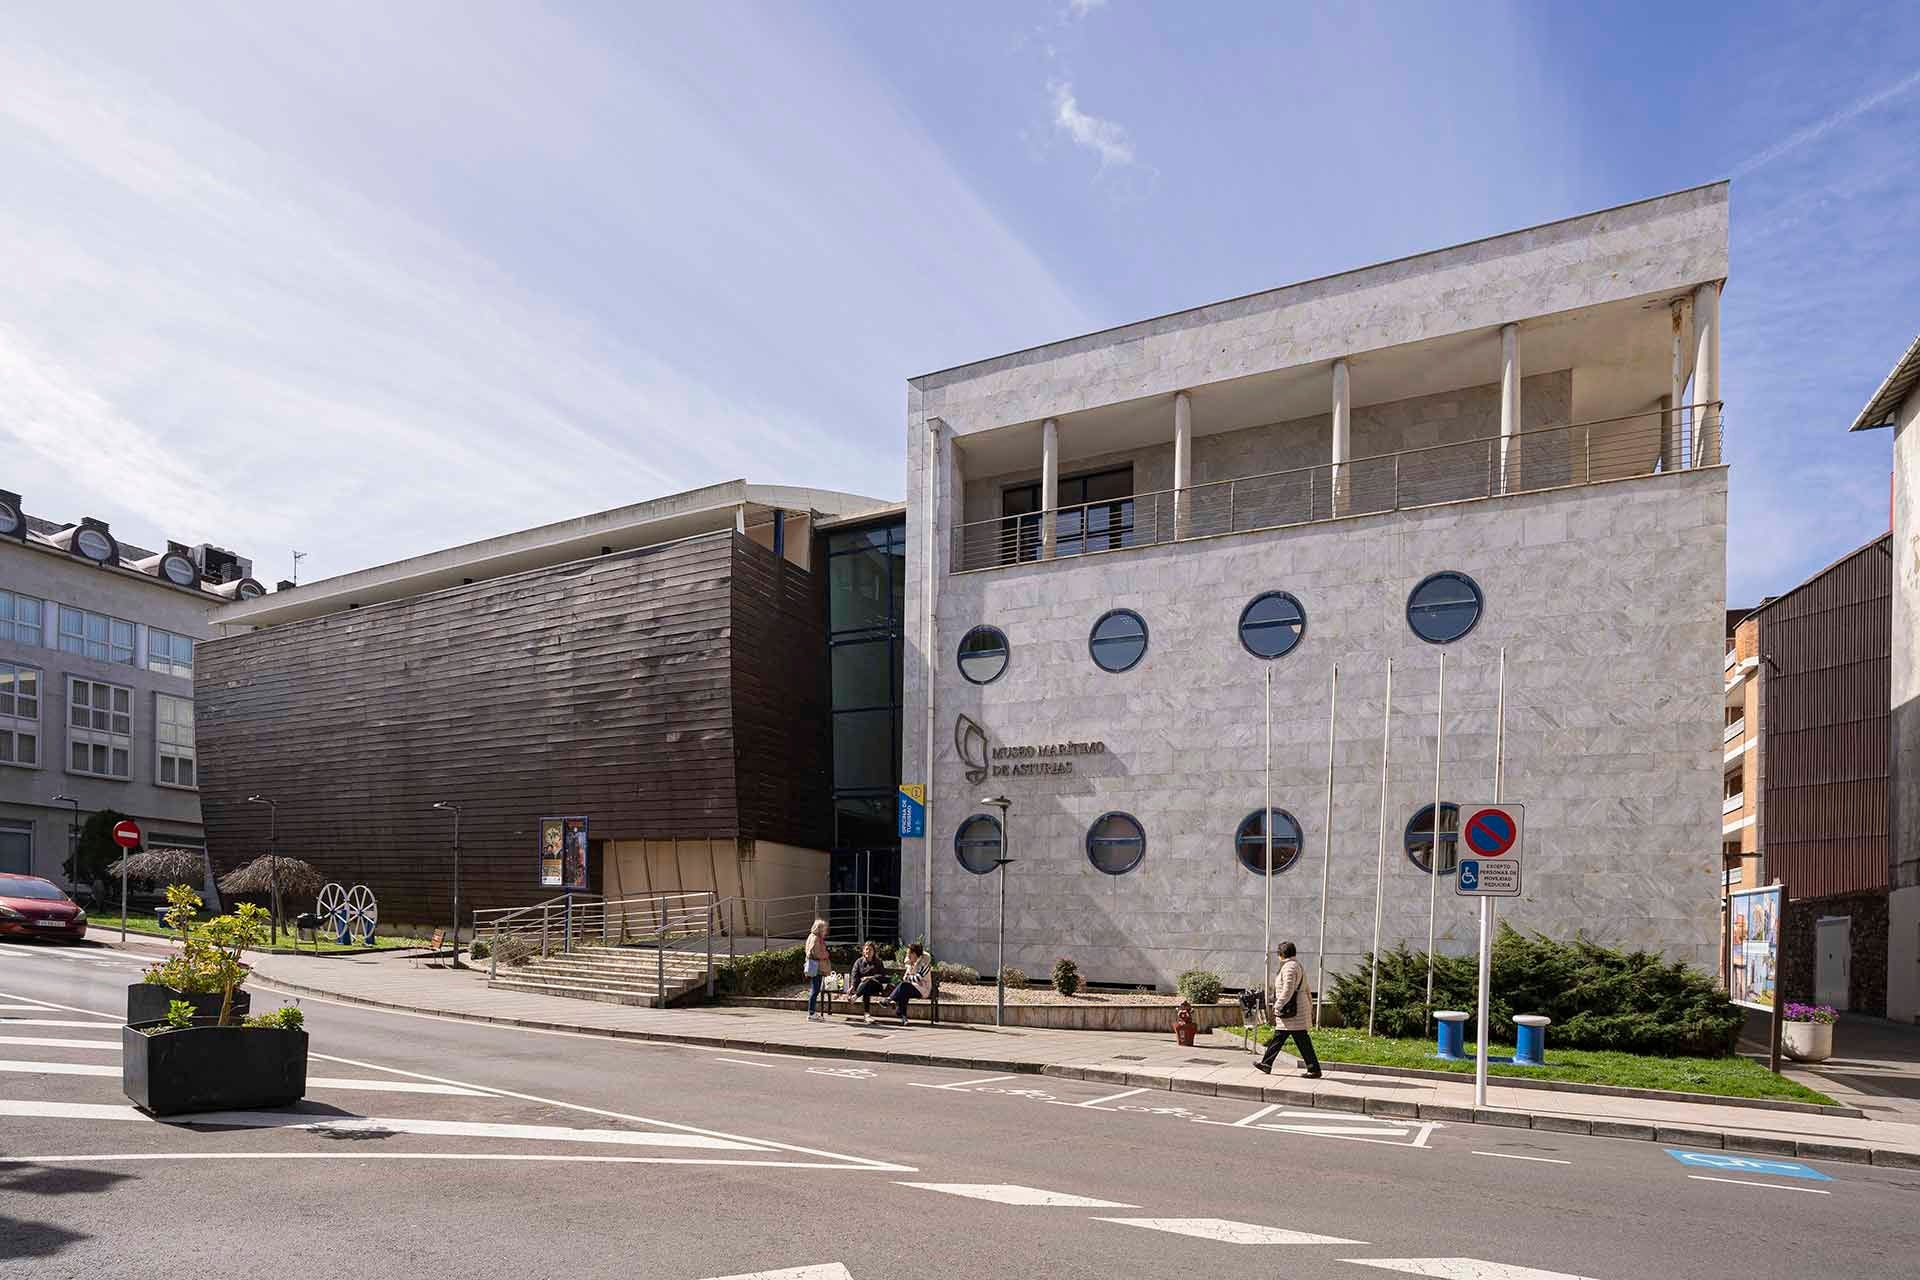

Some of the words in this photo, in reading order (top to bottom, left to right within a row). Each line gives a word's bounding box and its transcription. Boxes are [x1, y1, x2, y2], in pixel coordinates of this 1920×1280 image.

[992, 745, 1036, 760] MUSEO
[1038, 740, 1105, 758] MARÍTIMO
[992, 764, 1010, 777] DE
[1012, 761, 1073, 777] ASTURIAS
